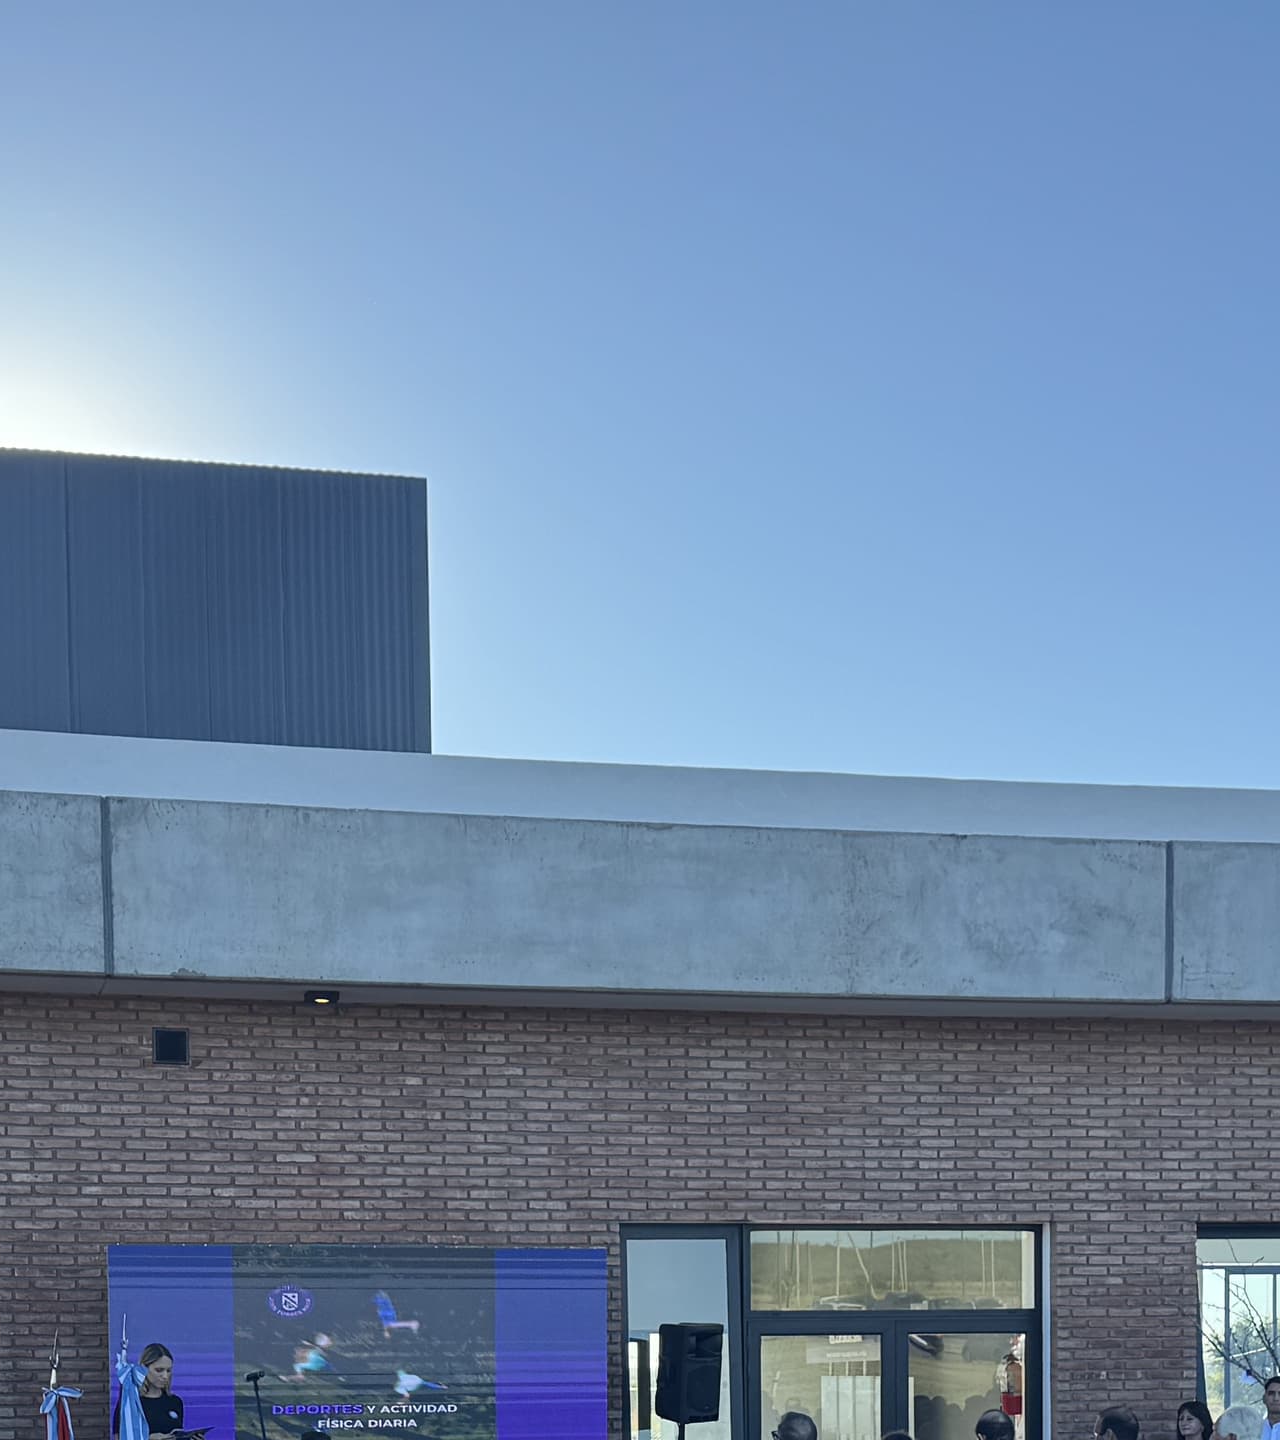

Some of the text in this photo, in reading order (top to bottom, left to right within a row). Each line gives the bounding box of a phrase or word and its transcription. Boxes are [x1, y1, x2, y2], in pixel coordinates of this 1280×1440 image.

[272, 1403, 458, 1415] DEPORTES Y ACTIVIDAD
[317, 1417, 418, 1429] FÍSICA DIARIA
